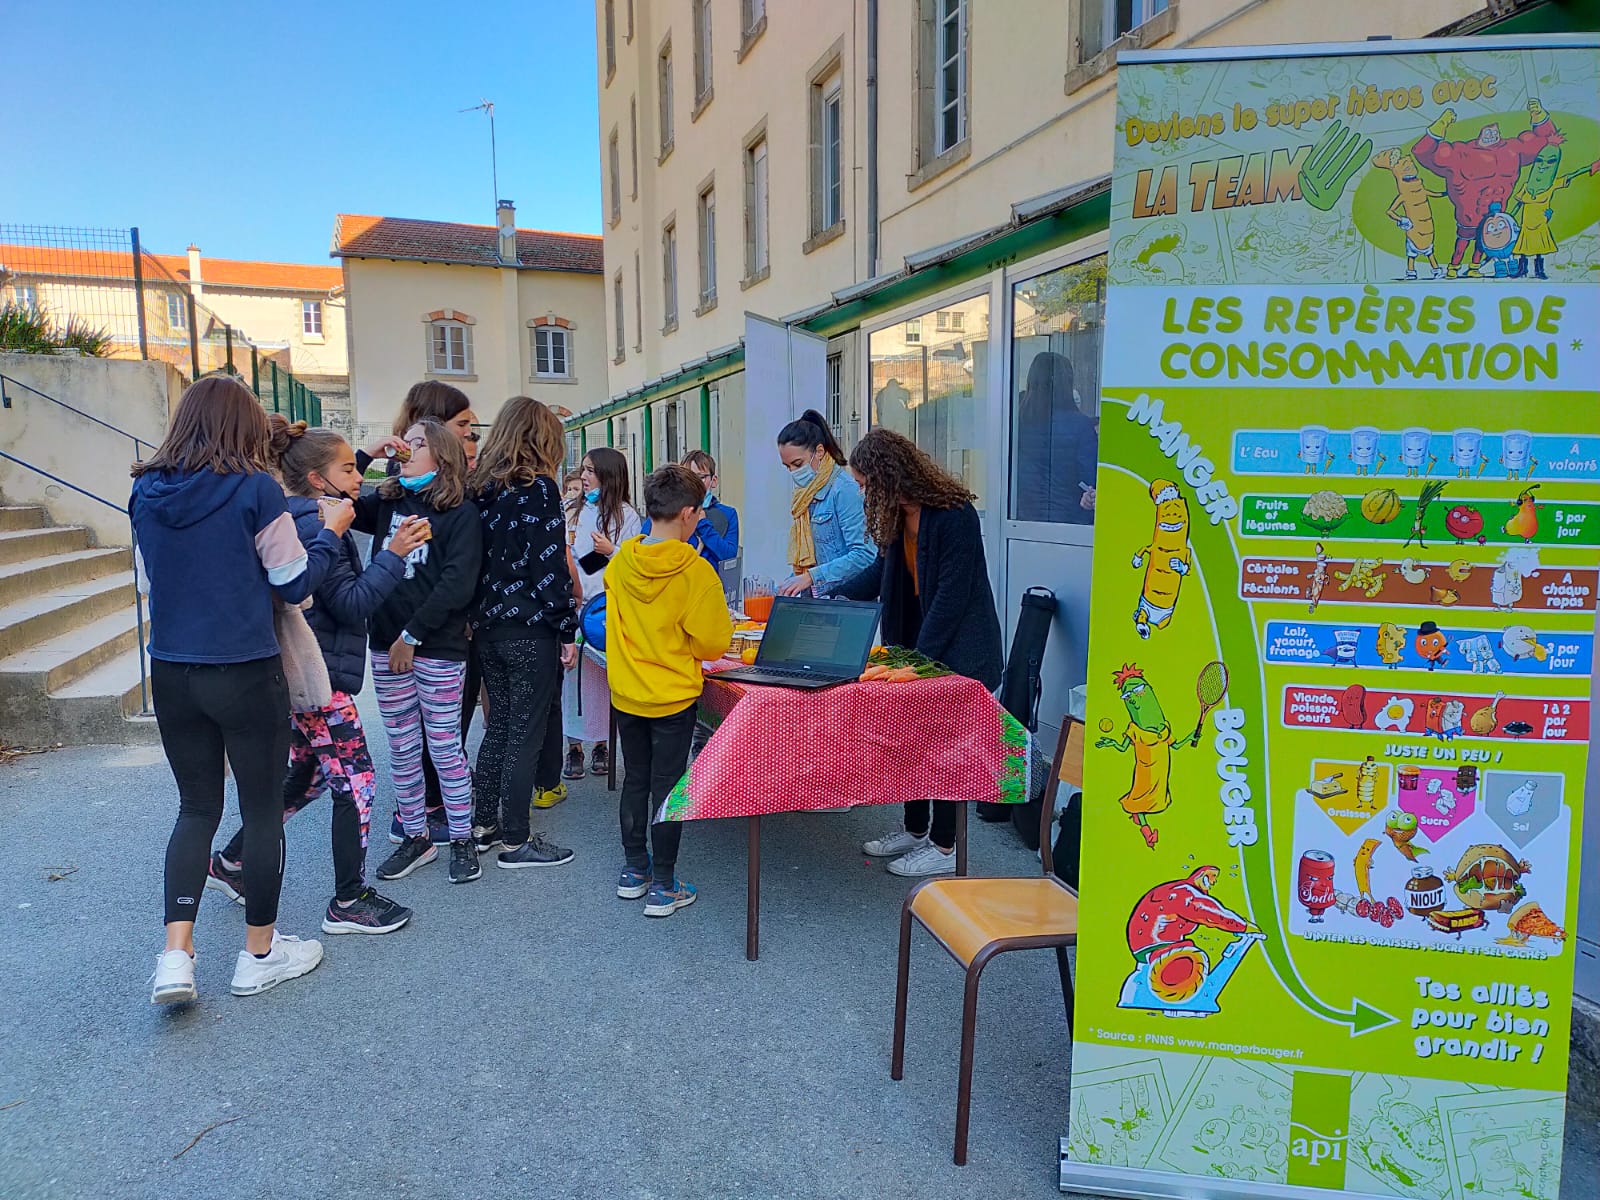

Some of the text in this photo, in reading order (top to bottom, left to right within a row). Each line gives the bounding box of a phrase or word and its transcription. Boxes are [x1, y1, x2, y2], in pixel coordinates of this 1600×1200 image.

[1125, 75, 1497, 147] Deviens le super héros avec
[1132, 144, 1314, 218] LA TEAM
[1162, 285, 1566, 336] LES REPÈRES DE
[1160, 340, 1558, 385] CONSOMMATION
[1126, 394, 1238, 525] MANGER
[1549, 458, 1597, 473] volonté
[1255, 500, 1289, 511] Fruits
[1266, 511, 1278, 520] et
[1555, 511, 1586, 526] 5 par
[1246, 520, 1296, 533] légumes
[1558, 525, 1580, 538] jour
[1247, 563, 1299, 575] Céréales
[1266, 575, 1278, 583] et
[1244, 583, 1300, 595] Féculents
[1543, 585, 1589, 598] chaque
[1546, 597, 1584, 610] repas
[1283, 627, 1308, 638] Lait,
[1274, 637, 1316, 649] yaourt,
[1270, 646, 1320, 659] fromage
[1547, 644, 1579, 657] 3 par
[1550, 657, 1575, 670] jour
[1293, 693, 1338, 705] Viande,
[1290, 703, 1339, 715] poisson,
[1543, 702, 1570, 715] 1 à 2
[1545, 716, 1567, 728] par
[1542, 726, 1567, 739] jour
[1383, 744, 1428, 758] JUSTE
[1433, 747, 1455, 760] UN
[1461, 749, 1493, 763] PEU
[1213, 708, 1258, 848] BOUGER
[1328, 808, 1371, 819] Graisses
[1420, 816, 1449, 827] Sucre
[1513, 822, 1529, 832] Sel
[1302, 881, 1334, 905] Soda
[1411, 890, 1443, 906] NIOUT
[1347, 934, 1366, 945] LES
[1369, 936, 1419, 950] GRAISSES
[1429, 942, 1465, 954] SUCRE
[1468, 945, 1481, 955] ET
[1483, 946, 1502, 957] SEL
[1415, 977, 1550, 1008] Tes alliés
[1412, 1007, 1550, 1038] pour bien
[1097, 1028, 1135, 1042] Source
[1145, 1034, 1175, 1046] PNNS
[1177, 1039, 1304, 1058] www.mangerbouger.fr
[1415, 1035, 1521, 1061] grandir
[1292, 1129, 1342, 1166] api
